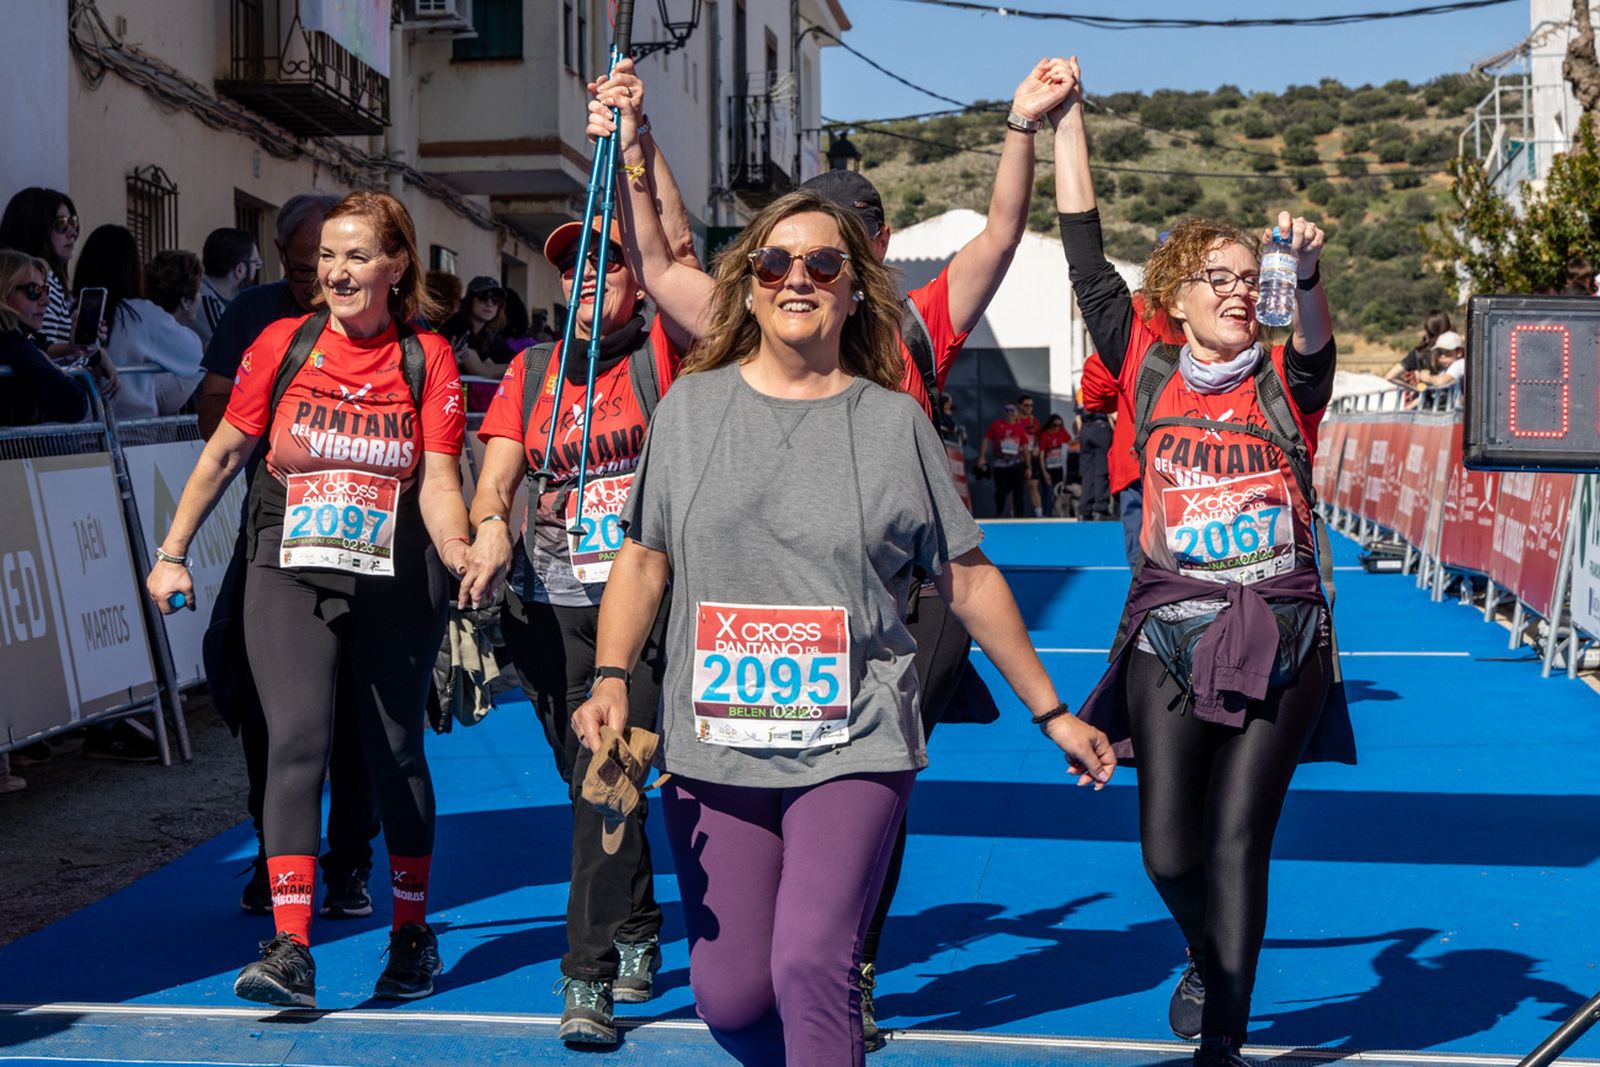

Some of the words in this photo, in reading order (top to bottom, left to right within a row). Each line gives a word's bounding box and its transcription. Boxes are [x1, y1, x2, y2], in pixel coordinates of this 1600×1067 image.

[291, 423, 310, 437] DEL
[294, 401, 414, 439] PANTANO
[309, 428, 414, 467] VÍBORAS
[1155, 457, 1175, 474] DEL
[1156, 433, 1280, 475] PANTANO
[304, 478, 320, 496] X
[323, 481, 378, 500] CROSS
[583, 486, 598, 507] X
[1181, 493, 1201, 516] X
[1205, 487, 1267, 511] CROSS
[290, 503, 388, 544] 2097
[577, 513, 625, 553] 20
[1174, 507, 1282, 564] 2067
[72, 514, 107, 576] JAÉN
[82, 604, 130, 651] MARTOS
[715, 612, 737, 639] X
[741, 622, 822, 642] CROSS
[715, 640, 803, 659] PANTANO
[701, 654, 840, 705] 2095
[728, 706, 767, 718] BELEN
